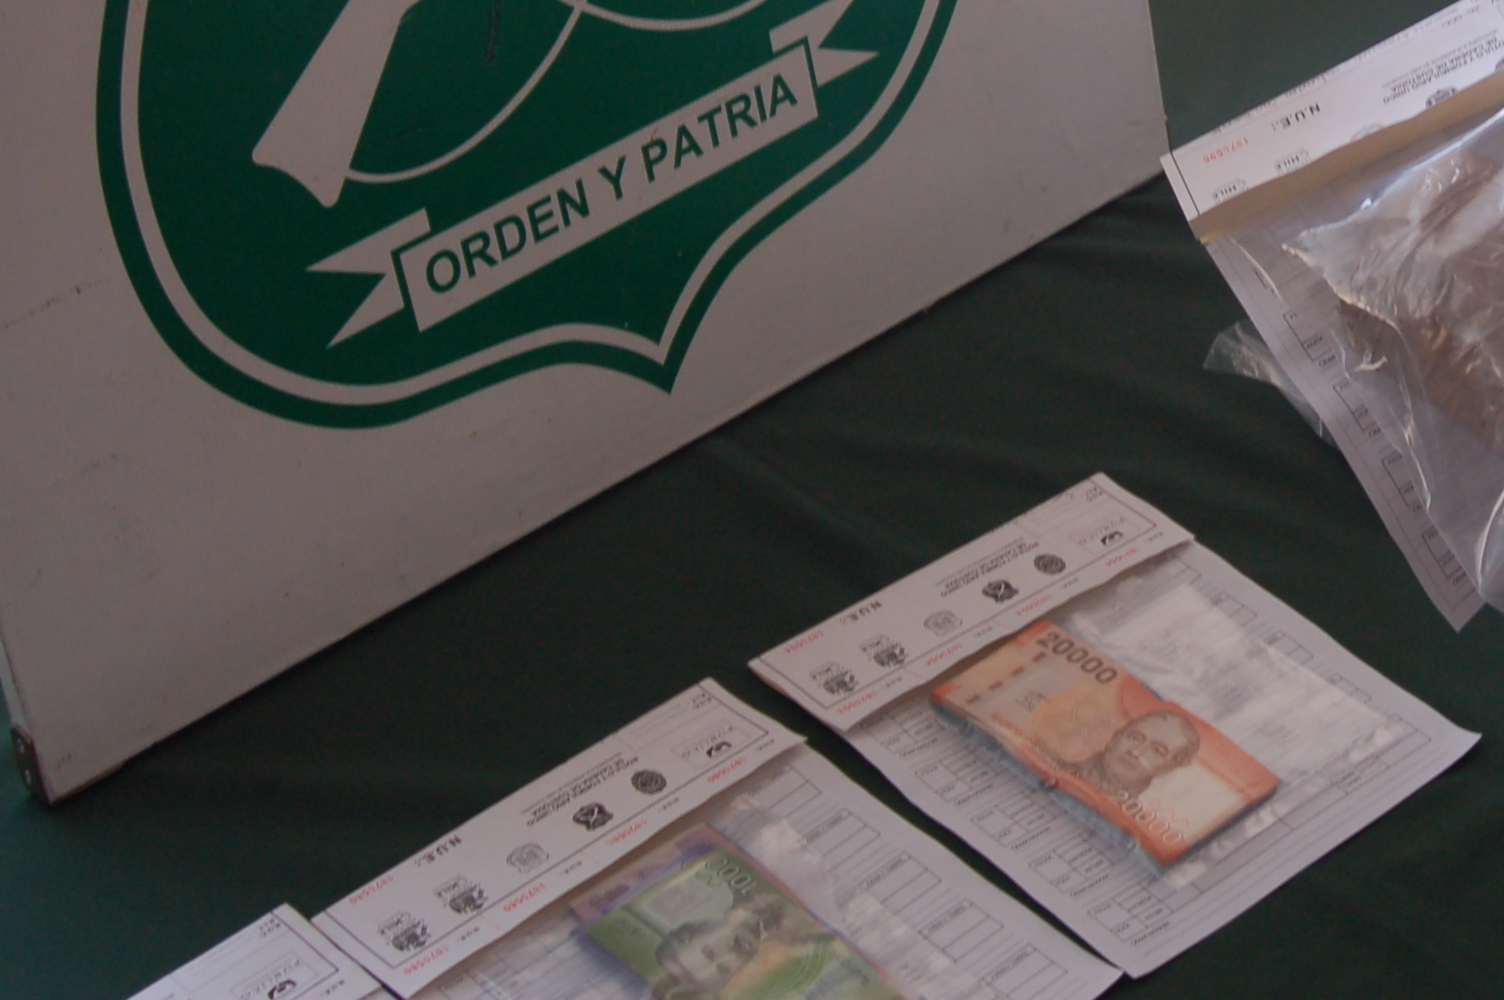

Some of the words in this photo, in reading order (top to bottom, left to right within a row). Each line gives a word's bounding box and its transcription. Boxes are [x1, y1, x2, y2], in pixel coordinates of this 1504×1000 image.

[425, 179, 590, 294] ORDEN
[598, 155, 628, 200] Y
[641, 73, 798, 182] PATRIA
[1037, 632, 1117, 685] 20000
[1117, 790, 1183, 844] 20000
